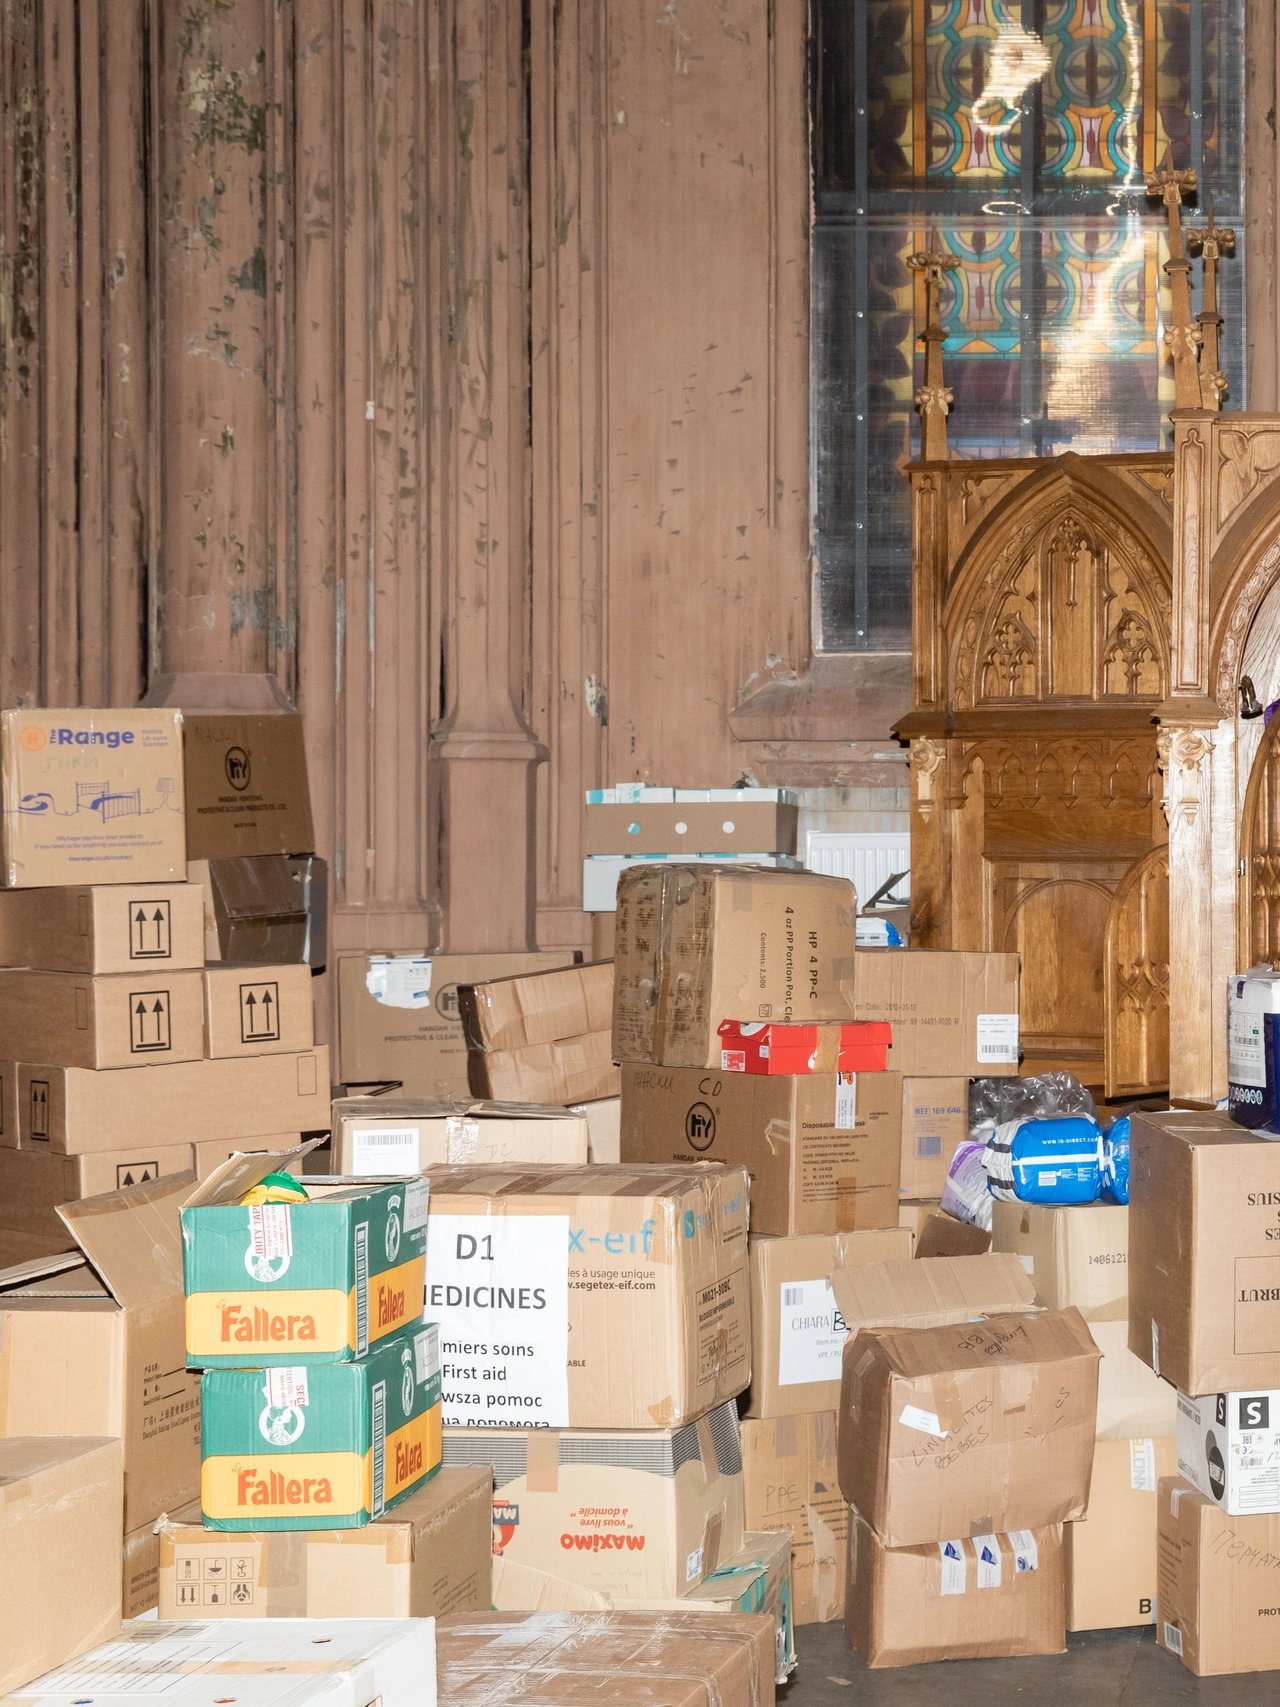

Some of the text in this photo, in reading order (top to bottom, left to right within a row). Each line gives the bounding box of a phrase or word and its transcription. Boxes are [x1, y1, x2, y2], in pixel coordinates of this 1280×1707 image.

[58, 728, 135, 748] Range
[785, 906, 794, 914] 4
[785, 918, 792, 928] oz
[786, 931, 793, 944] PP
[809, 931, 817, 949] HP
[786, 945, 794, 982] Portion
[809, 969, 818, 999] PP-C
[784, 984, 793, 1003] Pot,
[866, 1003, 881, 1011] Date:
[802, 1121, 835, 1129] Disposable
[673, 1153, 694, 1161] HANDAN
[456, 1233, 494, 1261] D1
[590, 1269, 618, 1280] usage
[621, 1269, 656, 1281] unique
[424, 1283, 546, 1310] EDICINES
[1238, 1287, 1280, 1302] BRUT
[378, 1285, 405, 1328] Fallera
[220, 1304, 316, 1342] Fallera
[792, 1315, 830, 1331] CHIARA
[493, 1343, 534, 1357] soins
[442, 1364, 507, 1381] First aid
[441, 1392, 543, 1409] wsza pomoc
[1218, 1398, 1224, 1420] S
[1247, 1402, 1261, 1424] S
[395, 1440, 422, 1485] Fallera
[237, 1469, 332, 1506] Fallera
[765, 1484, 800, 1512] PPE
[578, 1508, 629, 1517] à domicile
[580, 1518, 601, 1528] livre
[1139, 1598, 1152, 1614] B
